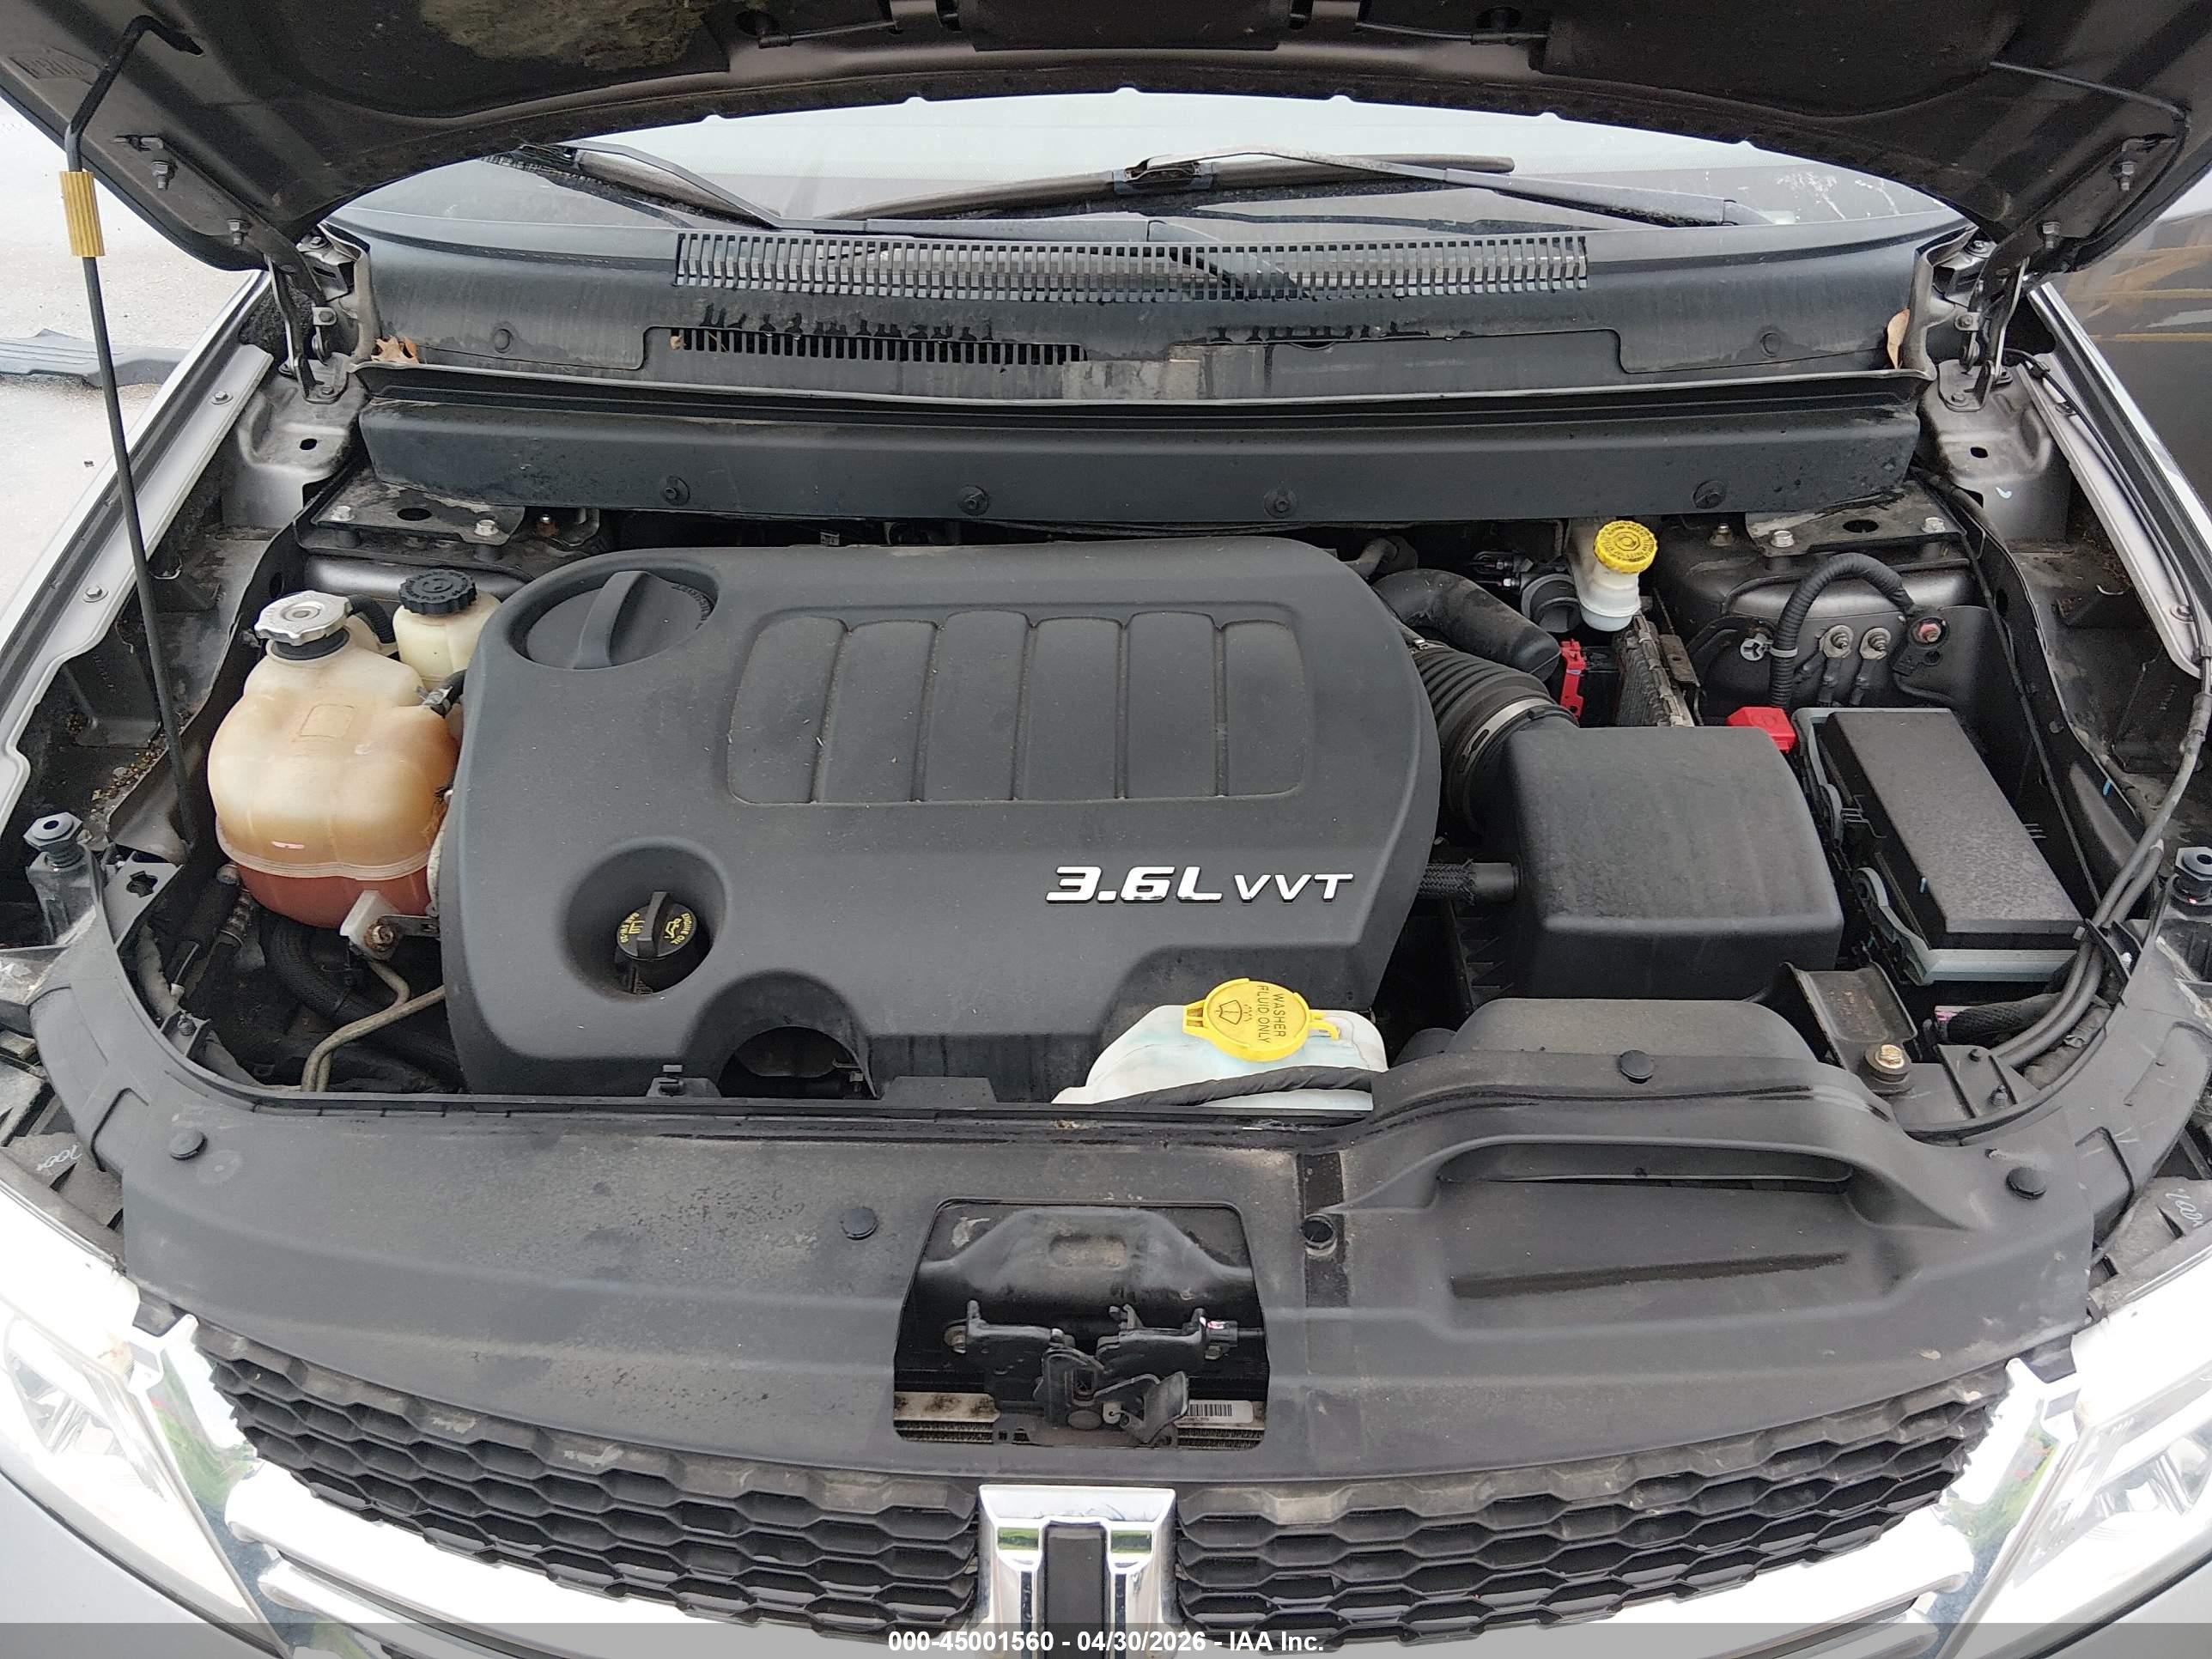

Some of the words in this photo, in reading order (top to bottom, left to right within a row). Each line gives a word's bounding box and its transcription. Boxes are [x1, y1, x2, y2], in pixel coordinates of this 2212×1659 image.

[1045, 866, 1224, 903] 3.6L
[1233, 873, 1354, 902] VVT
[681, 913, 692, 934] ENGINE
[670, 935, 685, 944] OIL
[1256, 985, 1269, 1015] FLUID
[1273, 993, 1286, 1038] WASHER
[1257, 1017, 1271, 1044] ONLY
